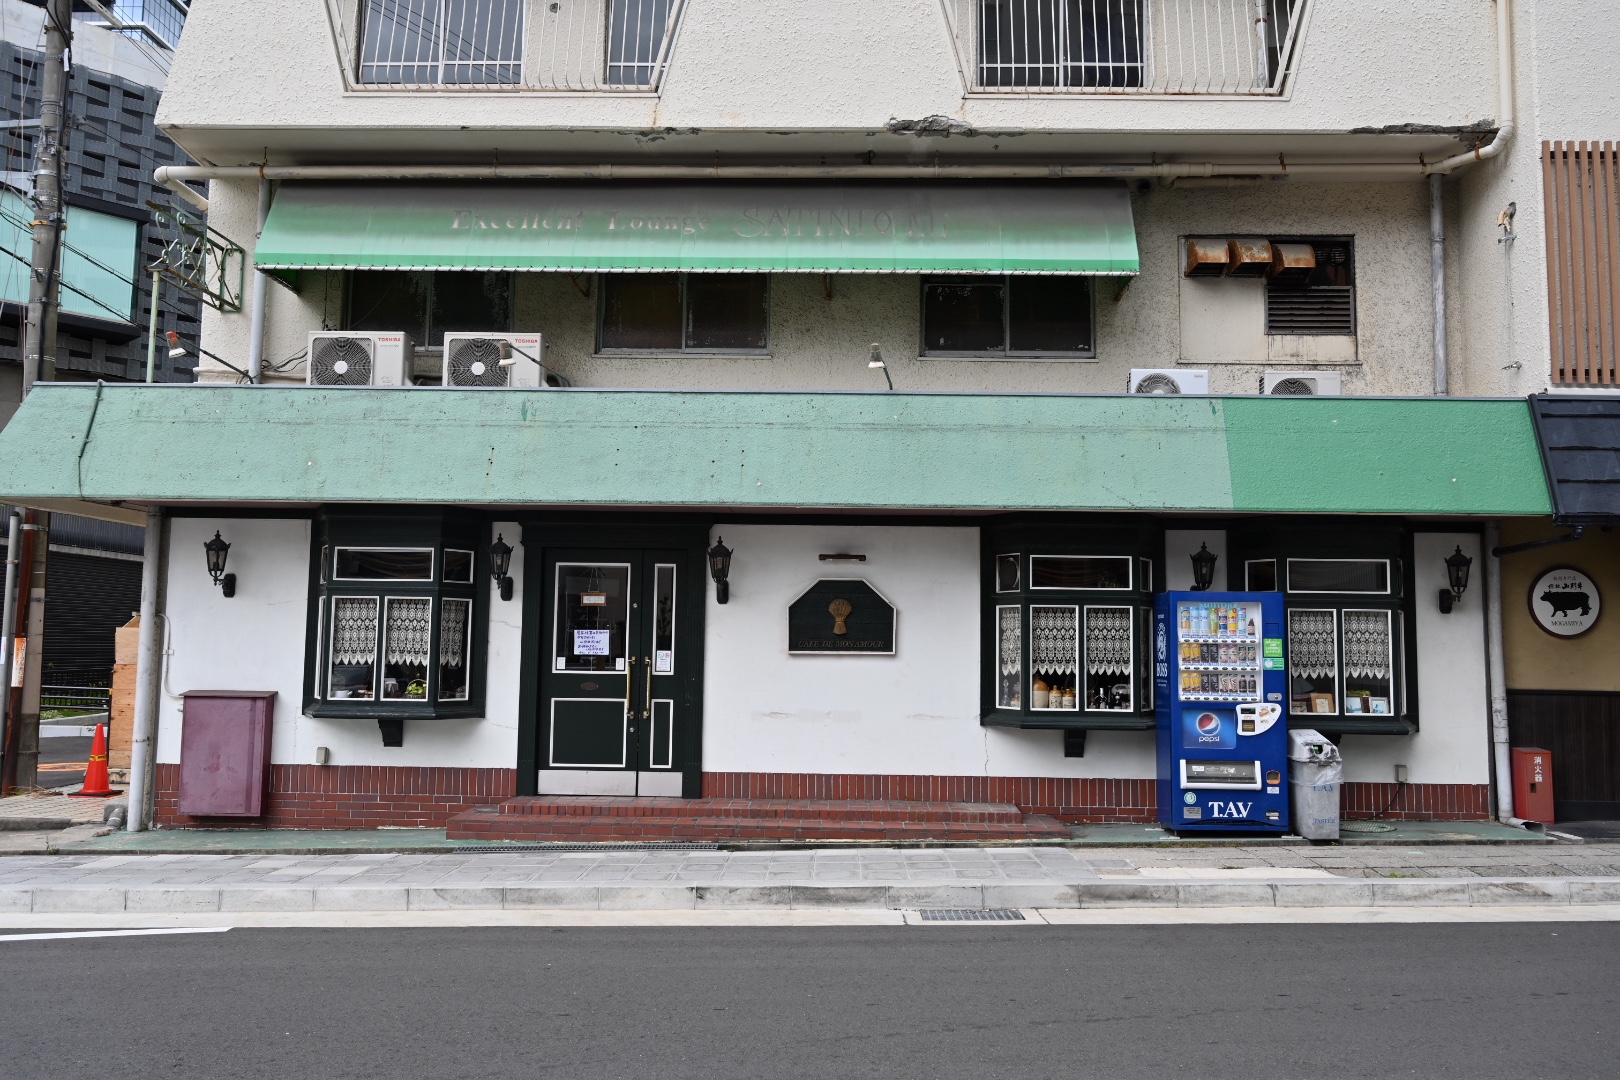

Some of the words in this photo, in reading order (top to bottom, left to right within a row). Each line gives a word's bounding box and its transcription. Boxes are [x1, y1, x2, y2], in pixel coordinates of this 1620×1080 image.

[451, 208, 585, 230] Excellent
[608, 209, 711, 235] Lounge
[822, 640, 833, 648] DE
[1156, 663, 1168, 677] BOSS
[1198, 736, 1220, 744] pepsi
[1533, 755, 1543, 783] 消火器
